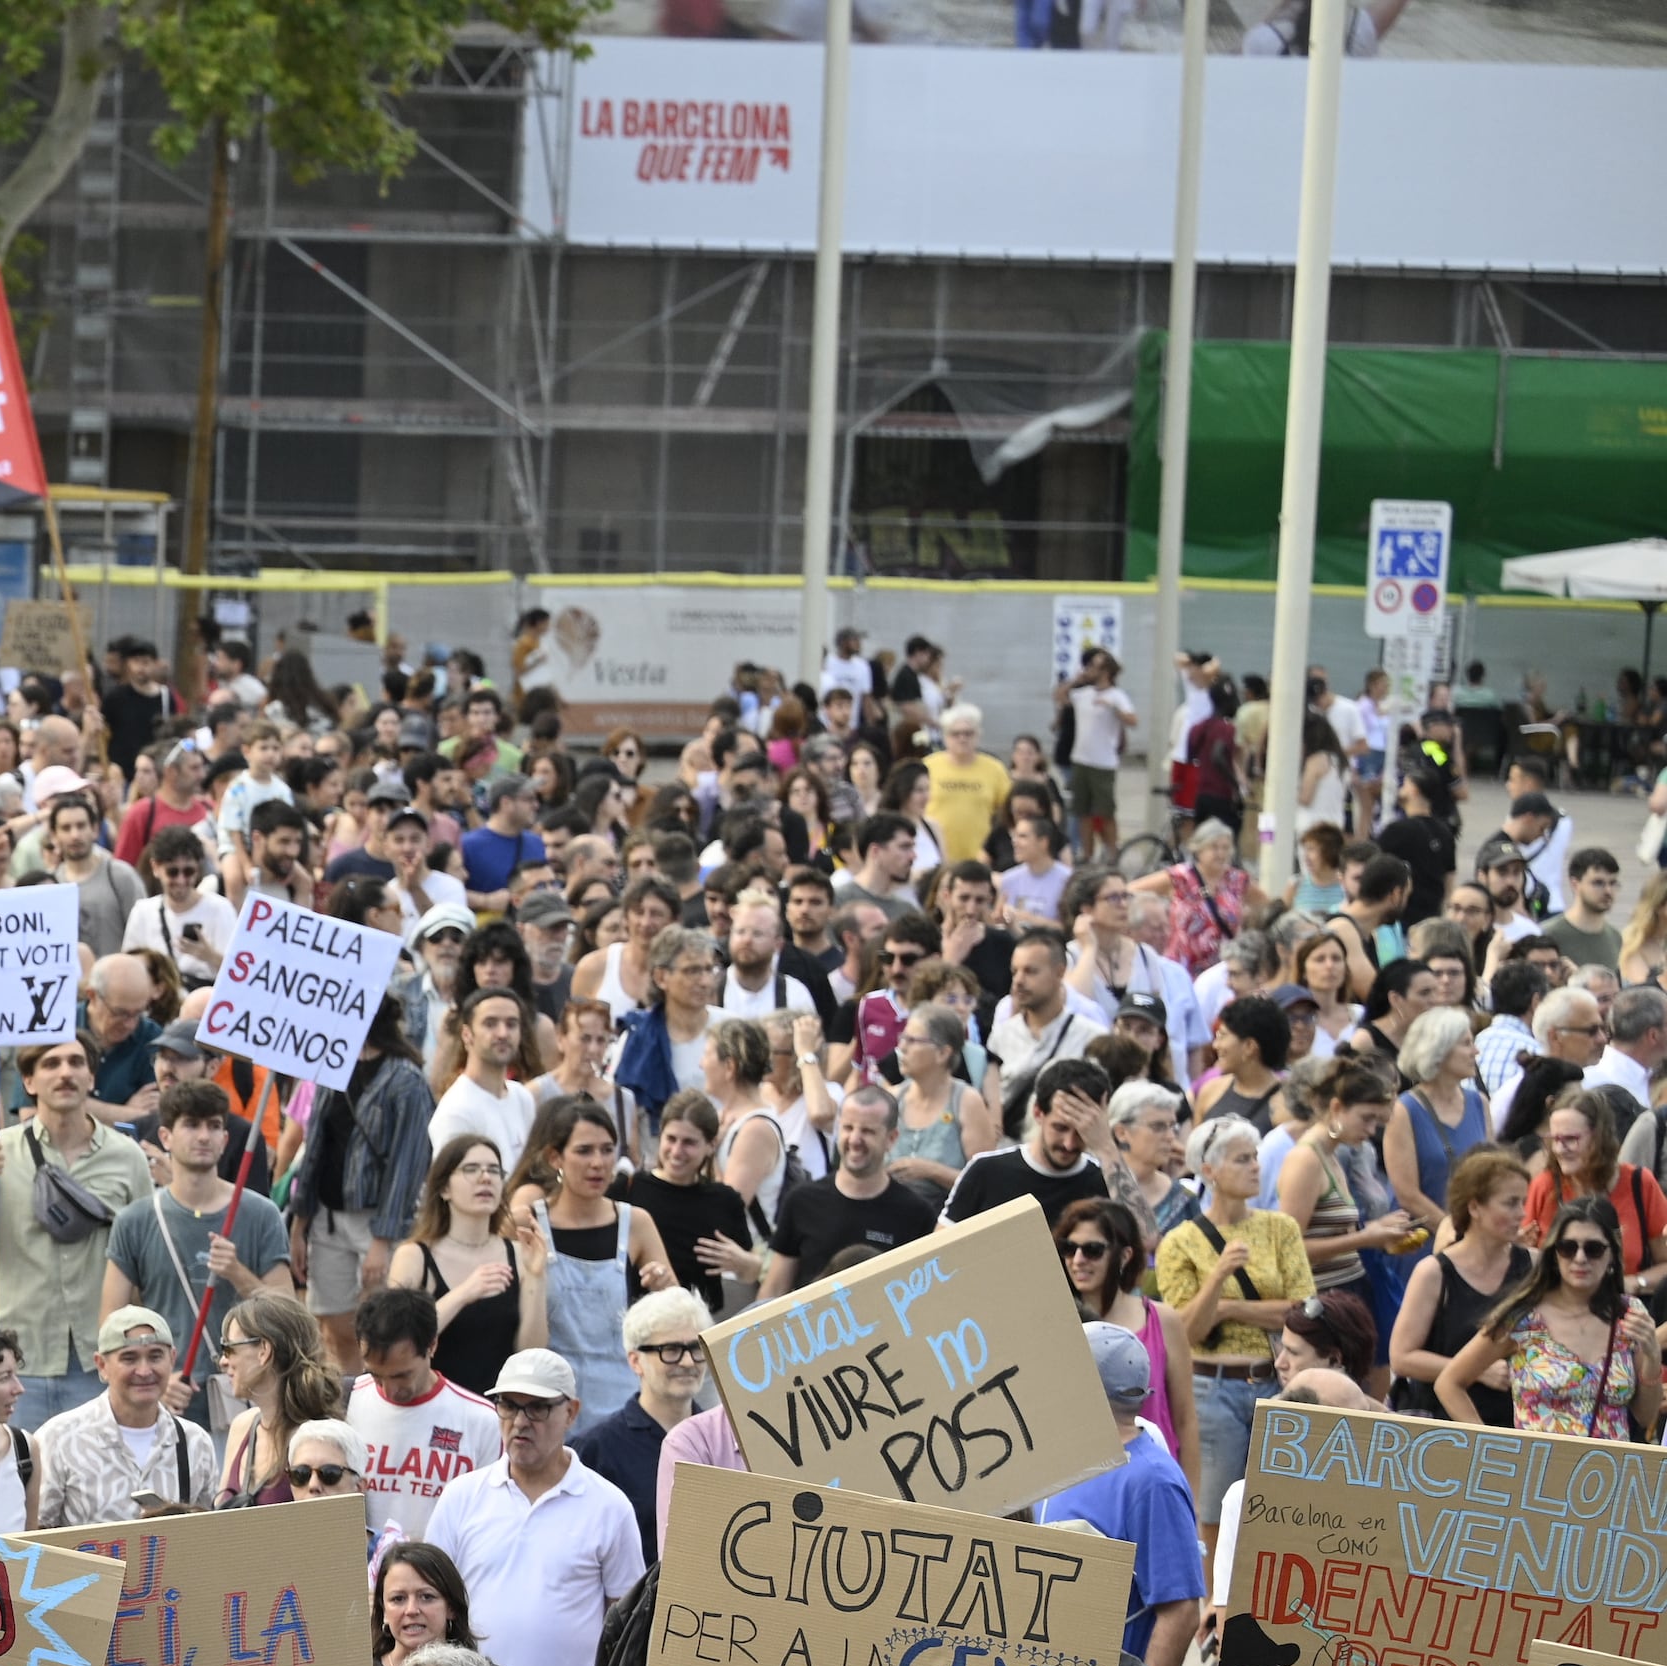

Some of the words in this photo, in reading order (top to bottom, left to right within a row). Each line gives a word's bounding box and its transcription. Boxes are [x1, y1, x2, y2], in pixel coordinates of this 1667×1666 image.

[581, 98, 615, 137] LA
[622, 100, 791, 142] BARCELONA
[636, 144, 694, 184] QUE
[695, 146, 761, 185] FEM
[246, 899, 363, 965] PAELLA
[16, 944, 71, 966] VOTI
[883, 1254, 958, 1336] per
[878, 1365, 1035, 1501] POST
[365, 1443, 474, 1482] GLAND
[1259, 1409, 1667, 1534] BARCELON
[409, 1481, 445, 1499] TEA
[1242, 1494, 1346, 1533] Barcelona
[1360, 1517, 1388, 1533] en
[1316, 1531, 1380, 1558] COMÚ
[1251, 1550, 1660, 1665] IDENTITAT
[661, 1604, 758, 1664] PER
